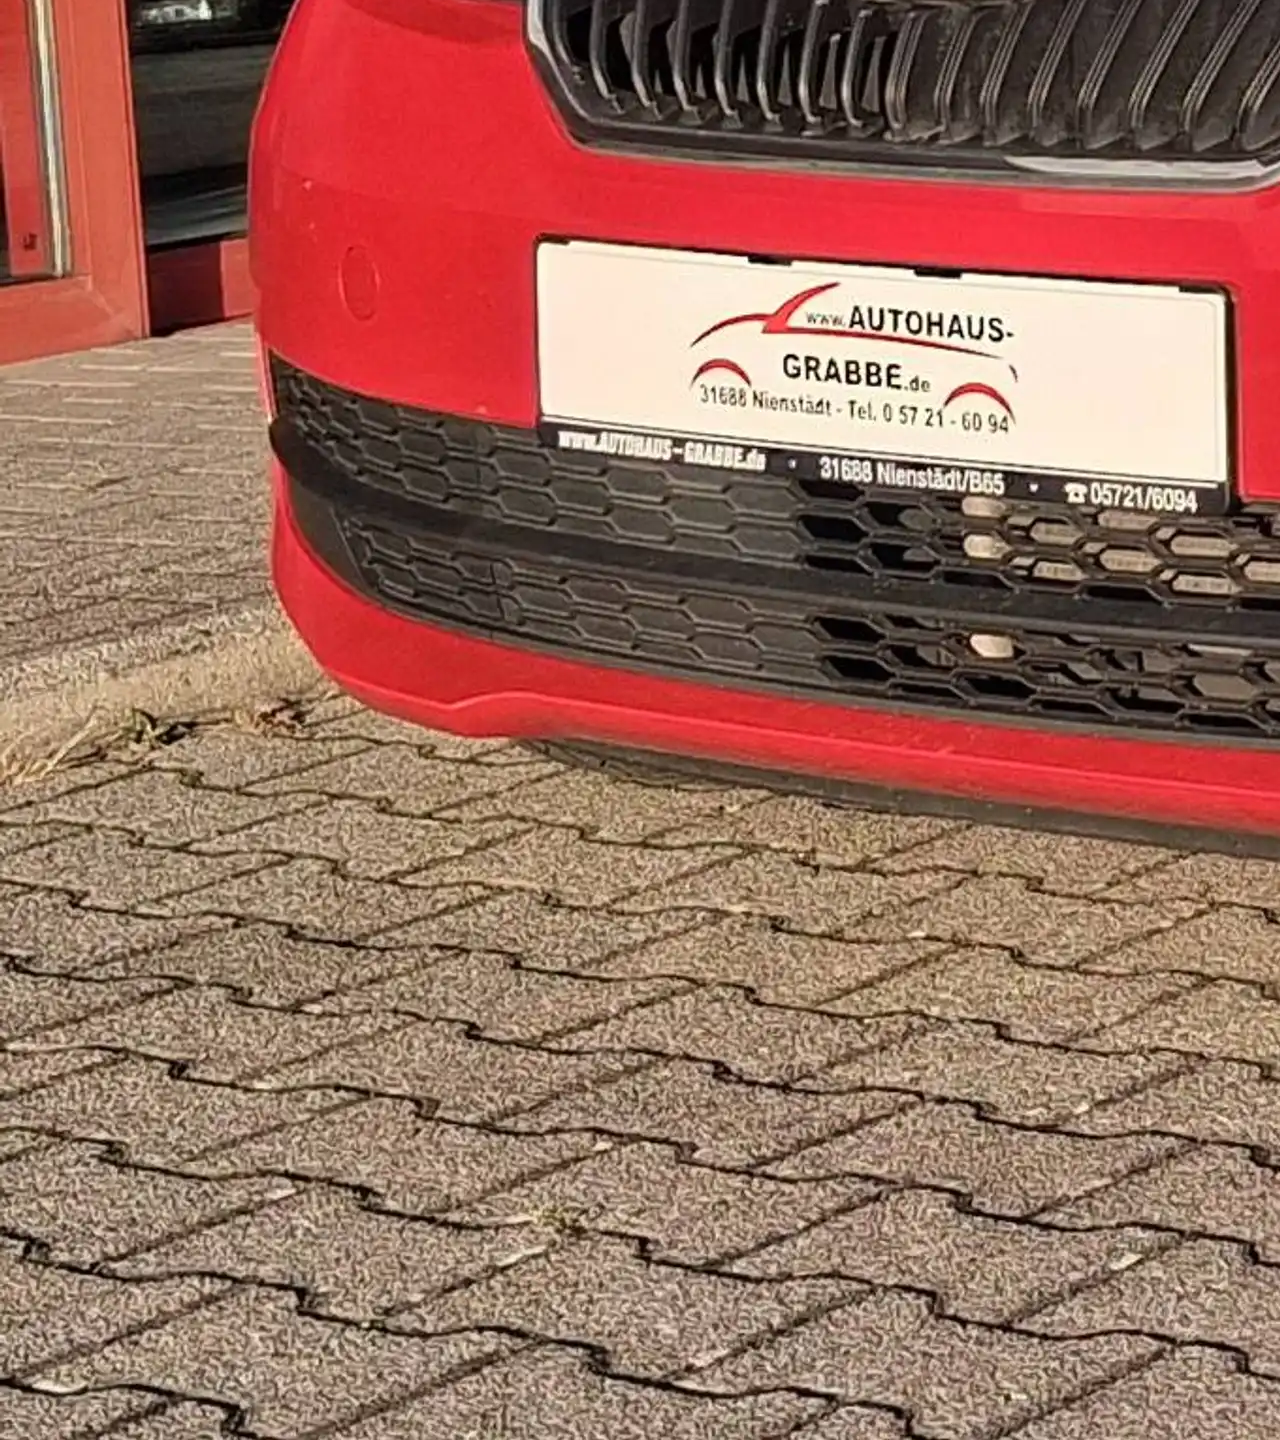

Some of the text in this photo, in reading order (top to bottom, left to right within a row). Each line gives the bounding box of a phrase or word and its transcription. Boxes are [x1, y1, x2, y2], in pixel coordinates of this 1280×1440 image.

[783, 353, 931, 393] GRABBE.de
[699, 384, 747, 408] 31688
[752, 389, 832, 416] Nienstädt
[848, 400, 877, 421] Tel.
[819, 457, 873, 484] 31688
[877, 465, 1006, 496] Nienstädt/B65
[1089, 482, 1199, 513] 05721/6094
